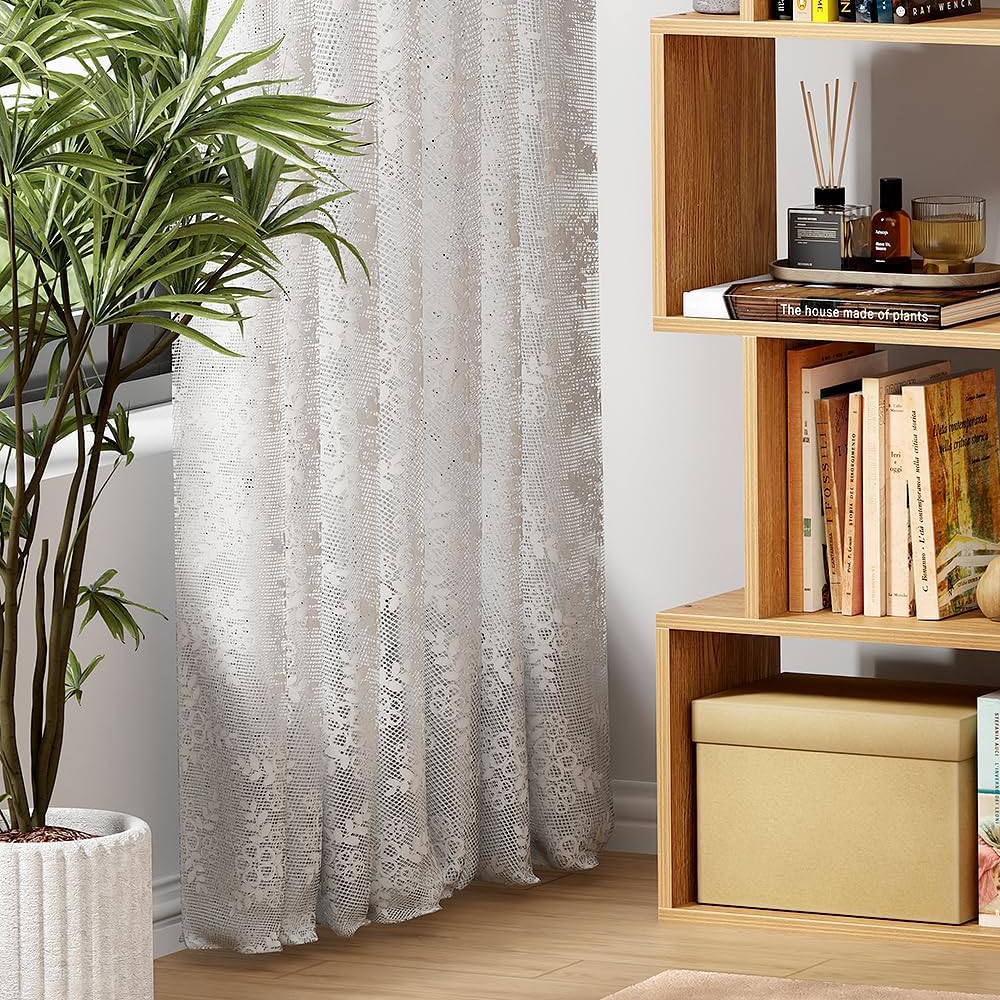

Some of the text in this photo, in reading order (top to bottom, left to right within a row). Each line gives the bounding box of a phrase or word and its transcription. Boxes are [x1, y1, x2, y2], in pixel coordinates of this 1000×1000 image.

[913, 4, 931, 17] RAY
[780, 303, 929, 323] The house made of plants
[948, 414, 988, 433] contemporanea
[911, 434, 919, 454] critica
[970, 431, 989, 445] storica
[849, 433, 857, 483] RISORGIMENTO
[912, 456, 920, 474] nella
[819, 432, 832, 511] FOSSILI
[890, 465, 903, 474] oggi
[915, 476, 924, 523] contemporanea
[917, 525, 926, 543] L'età
[920, 553, 928, 582] Bonanno
[921, 585, 929, 593] C.
